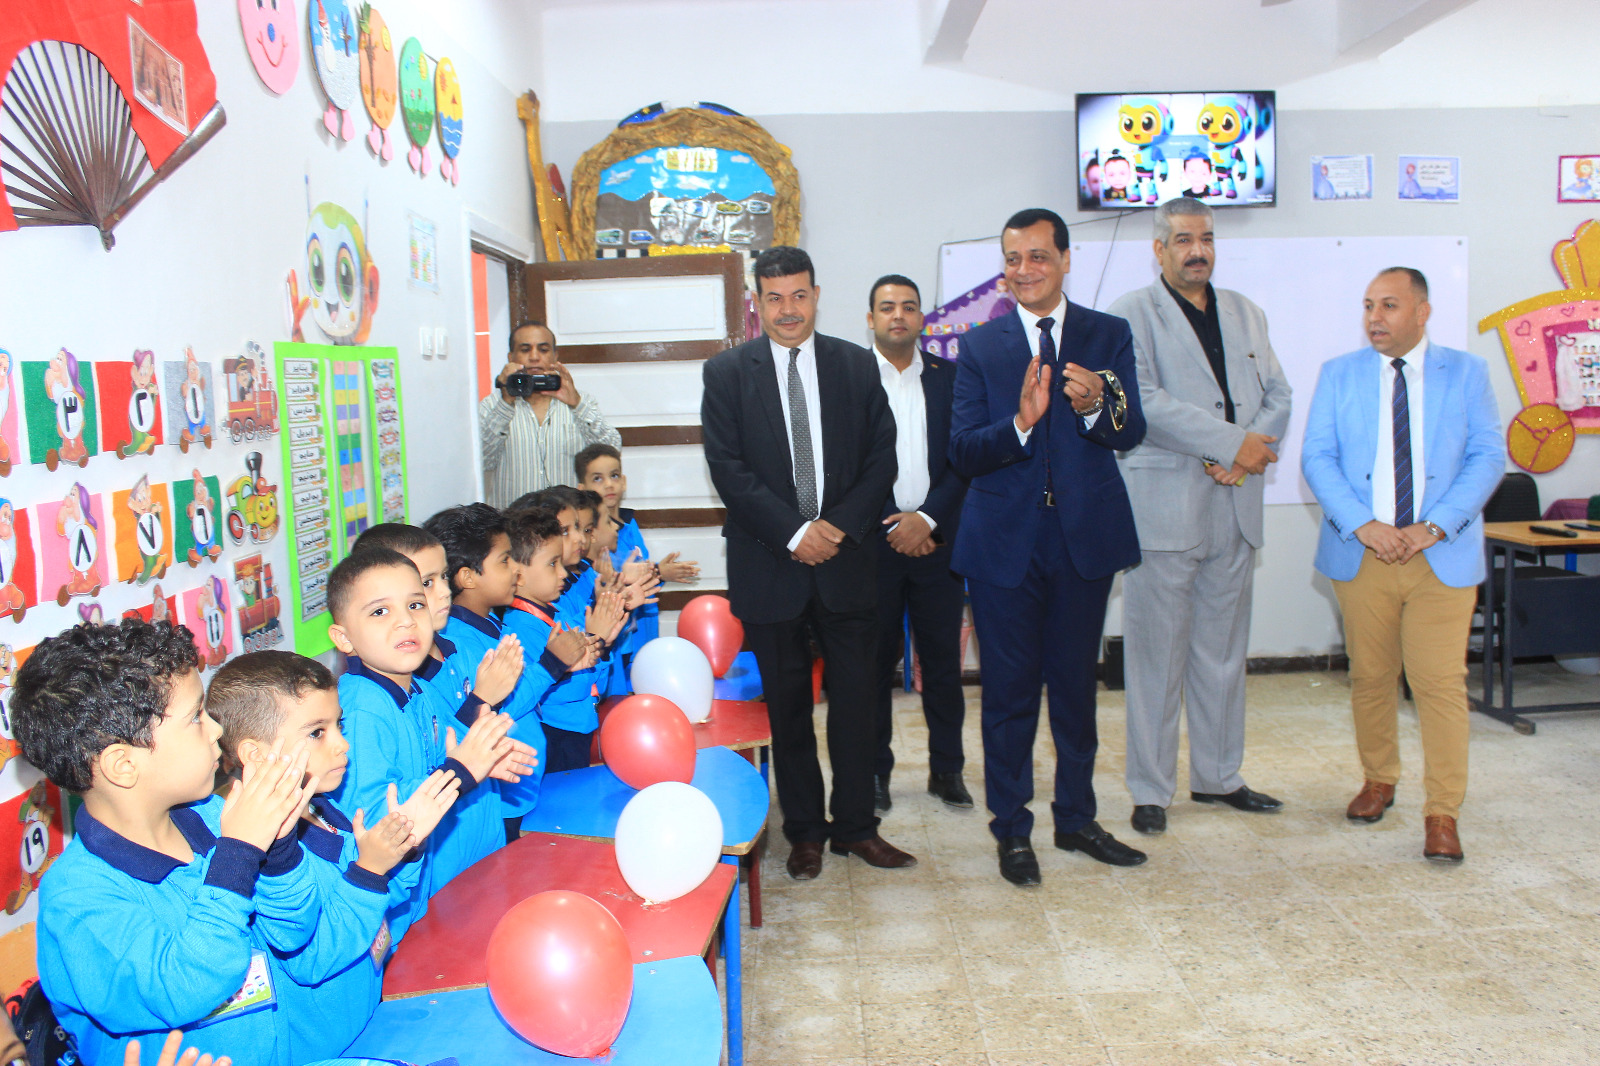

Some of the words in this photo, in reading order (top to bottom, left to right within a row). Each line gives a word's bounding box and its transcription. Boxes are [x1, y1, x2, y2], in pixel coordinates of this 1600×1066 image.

[191, 387, 199, 419] ١
[291, 385, 310, 396] فبراير
[63, 396, 78, 433] ٣
[135, 391, 148, 427] ٢
[293, 405, 313, 416] مارس
[299, 449, 314, 460] مايو
[300, 491, 319, 504] يوليو
[138, 514, 155, 550] ٧
[197, 507, 209, 541] ٦
[75, 528, 92, 567] ٨
[208, 613, 220, 643] ١١
[25, 827, 46, 866] ١٩
